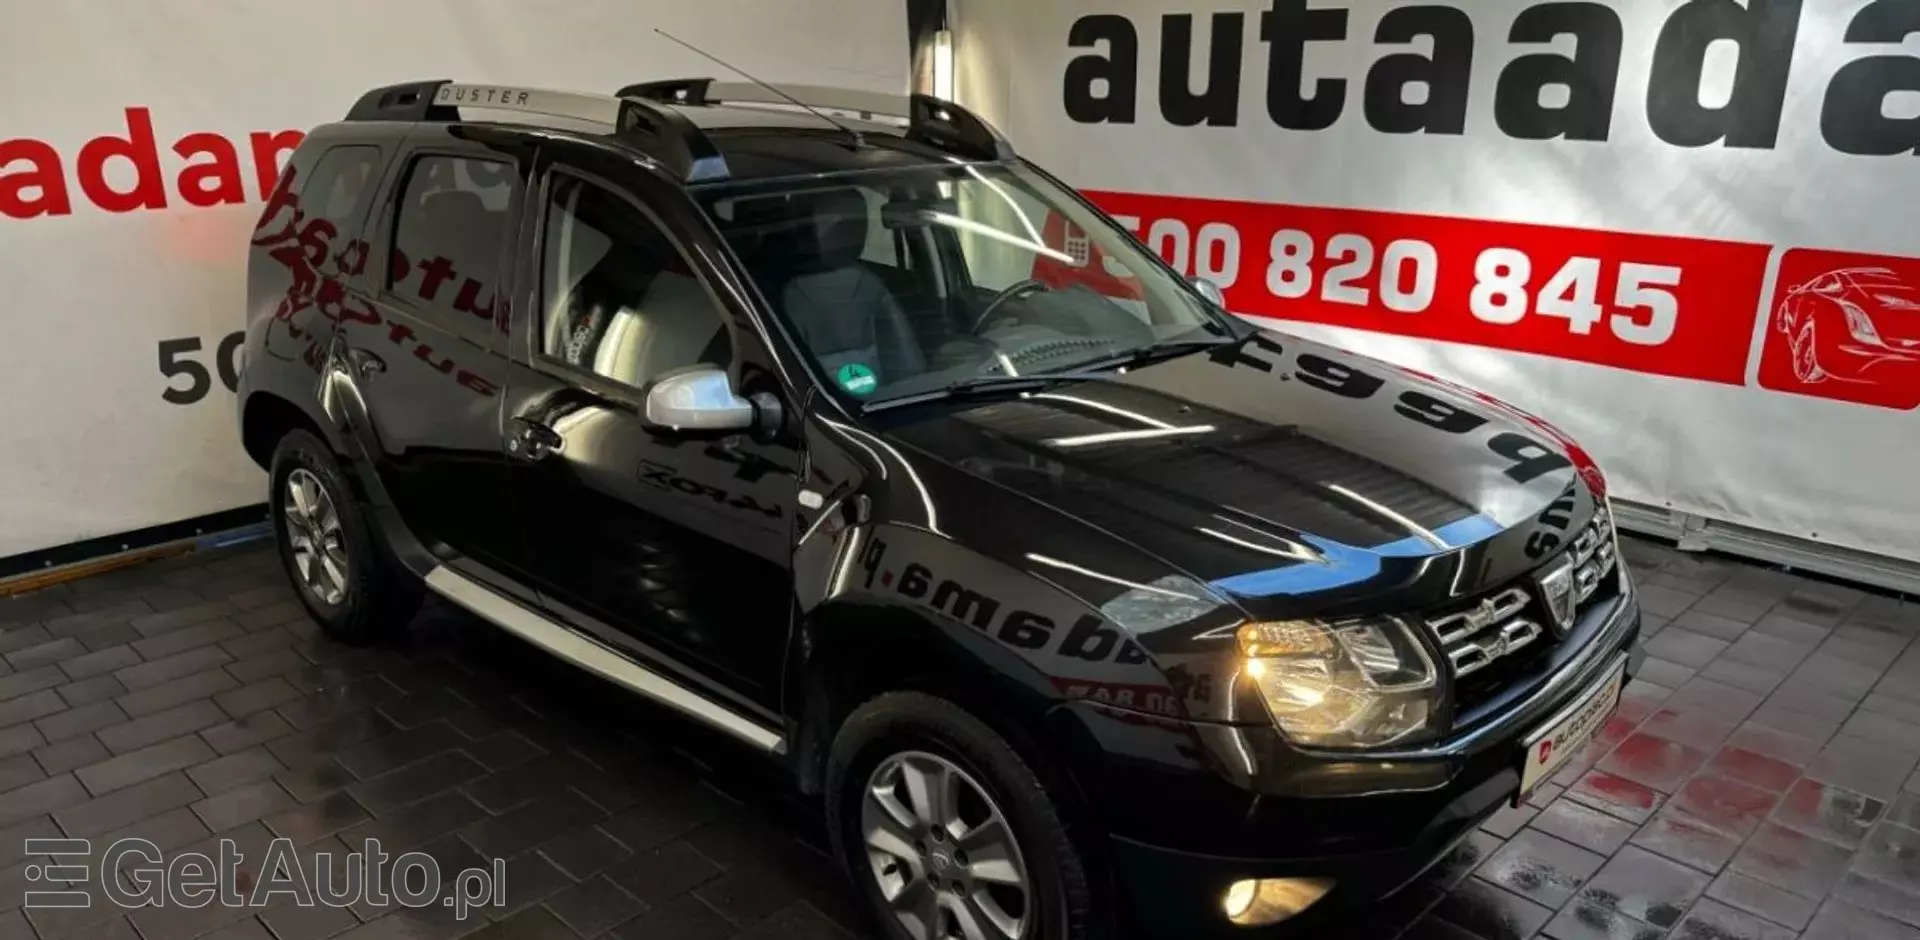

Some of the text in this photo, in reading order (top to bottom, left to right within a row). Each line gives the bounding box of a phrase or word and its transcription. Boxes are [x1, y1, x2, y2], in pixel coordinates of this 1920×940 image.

[440, 87, 529, 106] DUSTER
[1266, 228, 1438, 314] 820
[1469, 247, 1682, 346] 845
